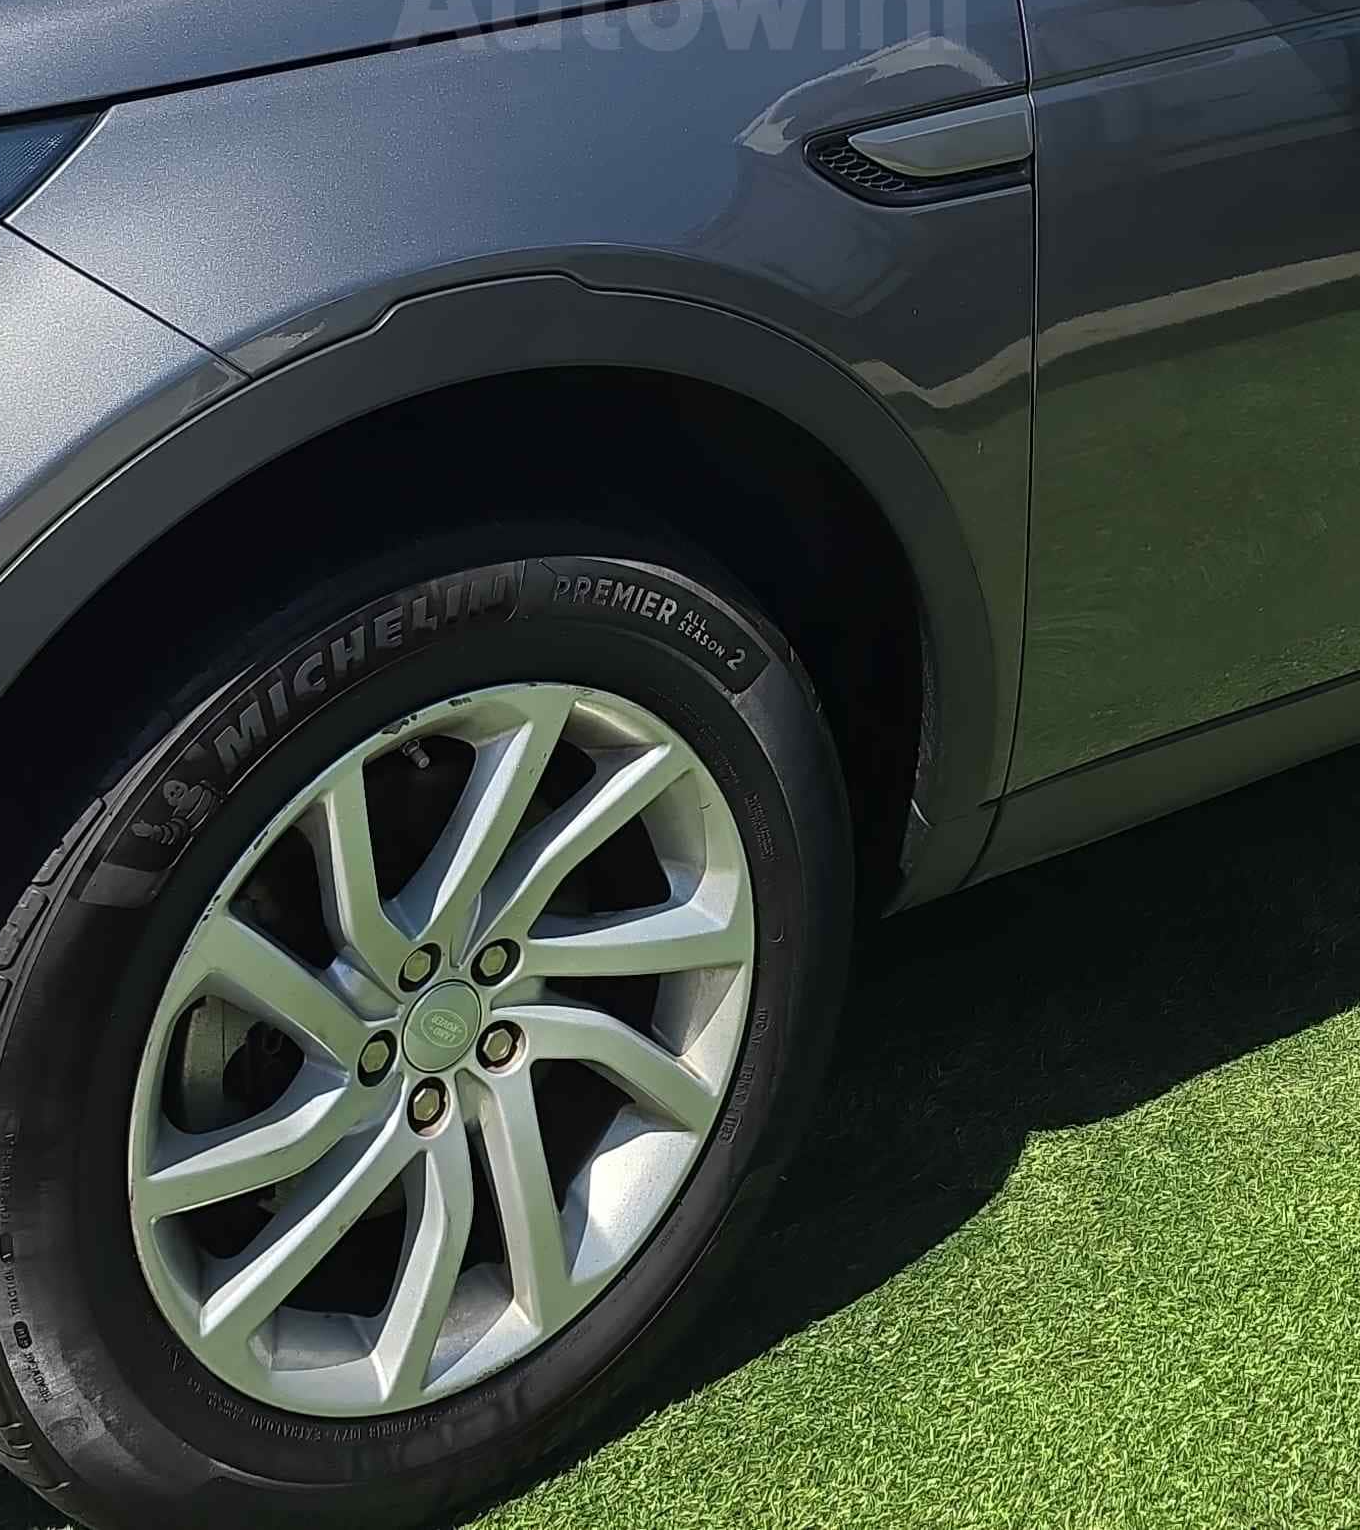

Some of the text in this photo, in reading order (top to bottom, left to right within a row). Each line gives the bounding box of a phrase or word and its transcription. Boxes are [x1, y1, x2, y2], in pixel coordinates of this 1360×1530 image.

[553, 574, 679, 625] PREMIER
[683, 610, 708, 632] ALL
[677, 620, 746, 671] SEASON 2
[213, 572, 512, 774] MICHELIN
